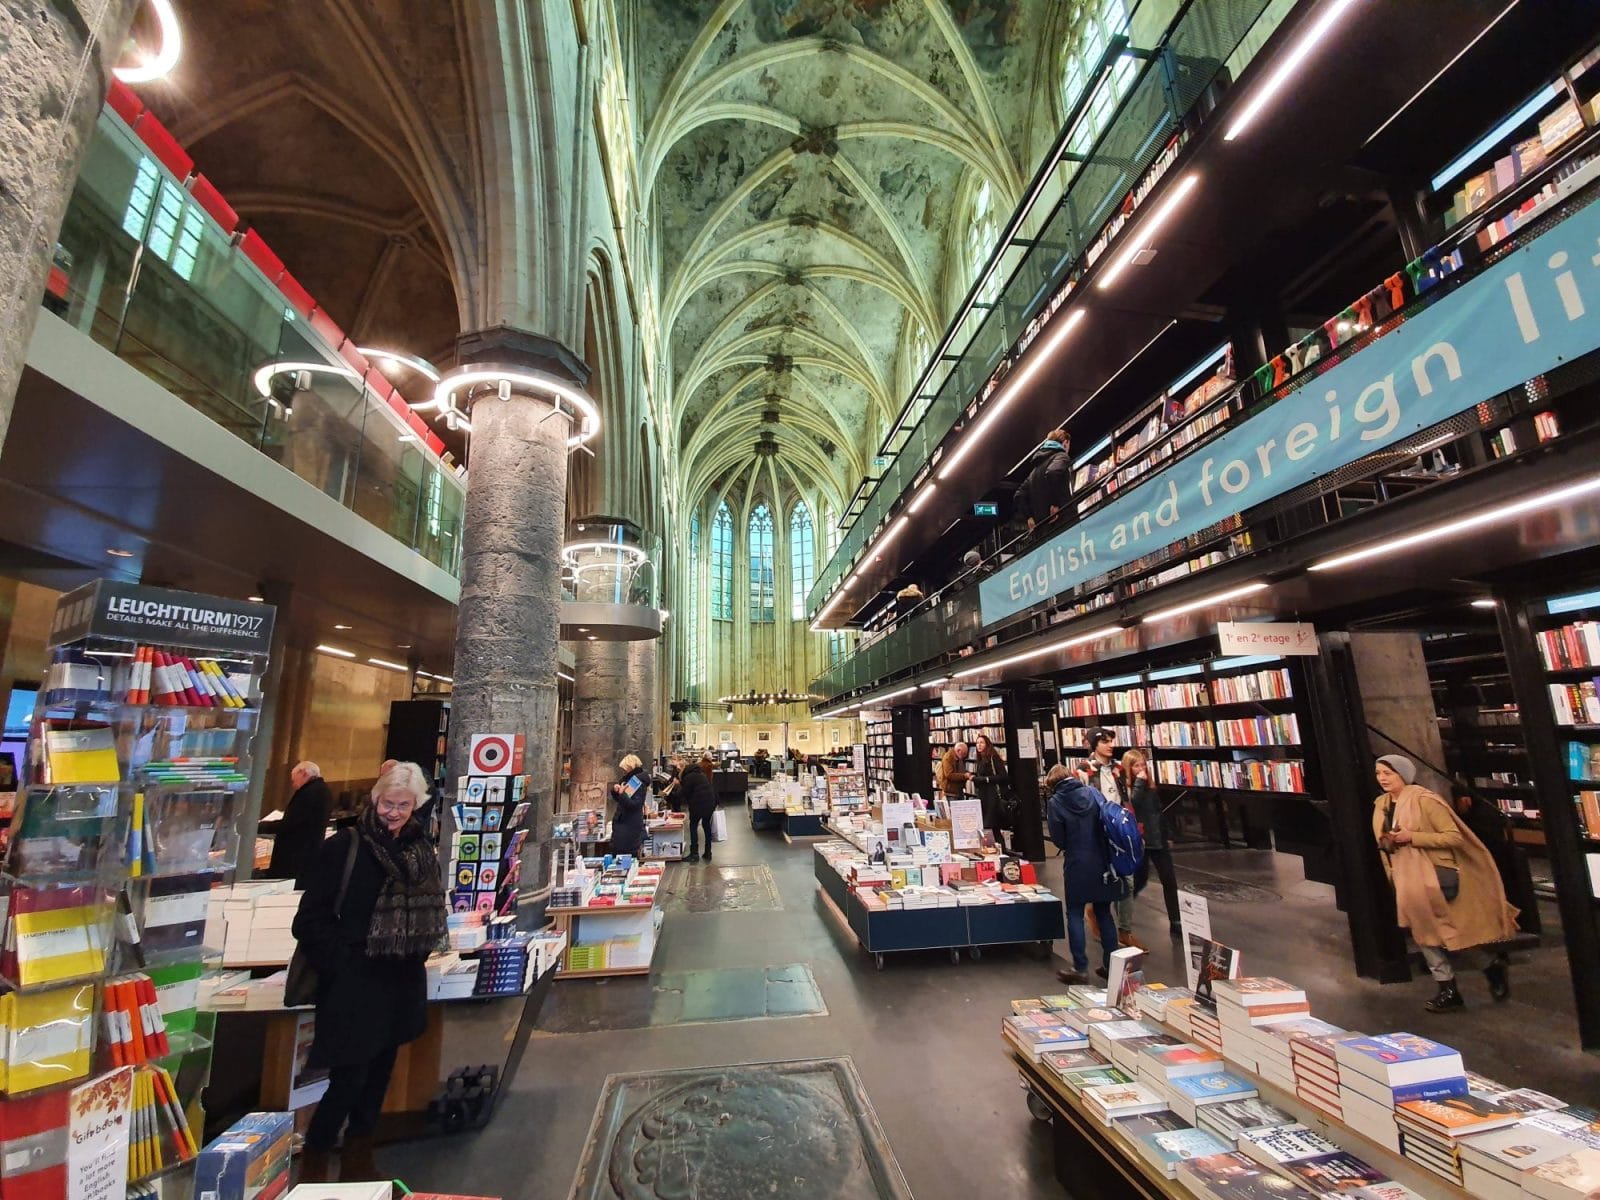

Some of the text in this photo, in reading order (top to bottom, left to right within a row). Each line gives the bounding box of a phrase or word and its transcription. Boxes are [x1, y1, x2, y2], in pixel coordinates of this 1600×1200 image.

[1009, 236, 1600, 601] English and foreign li
[106, 612, 144, 624] DETAILS
[145, 617, 173, 628] MAKE
[175, 621, 190, 630] ALL
[192, 623, 208, 632] THE
[108, 596, 264, 631] LEUCHTTURM1917
[1263, 634, 1290, 645] etage
